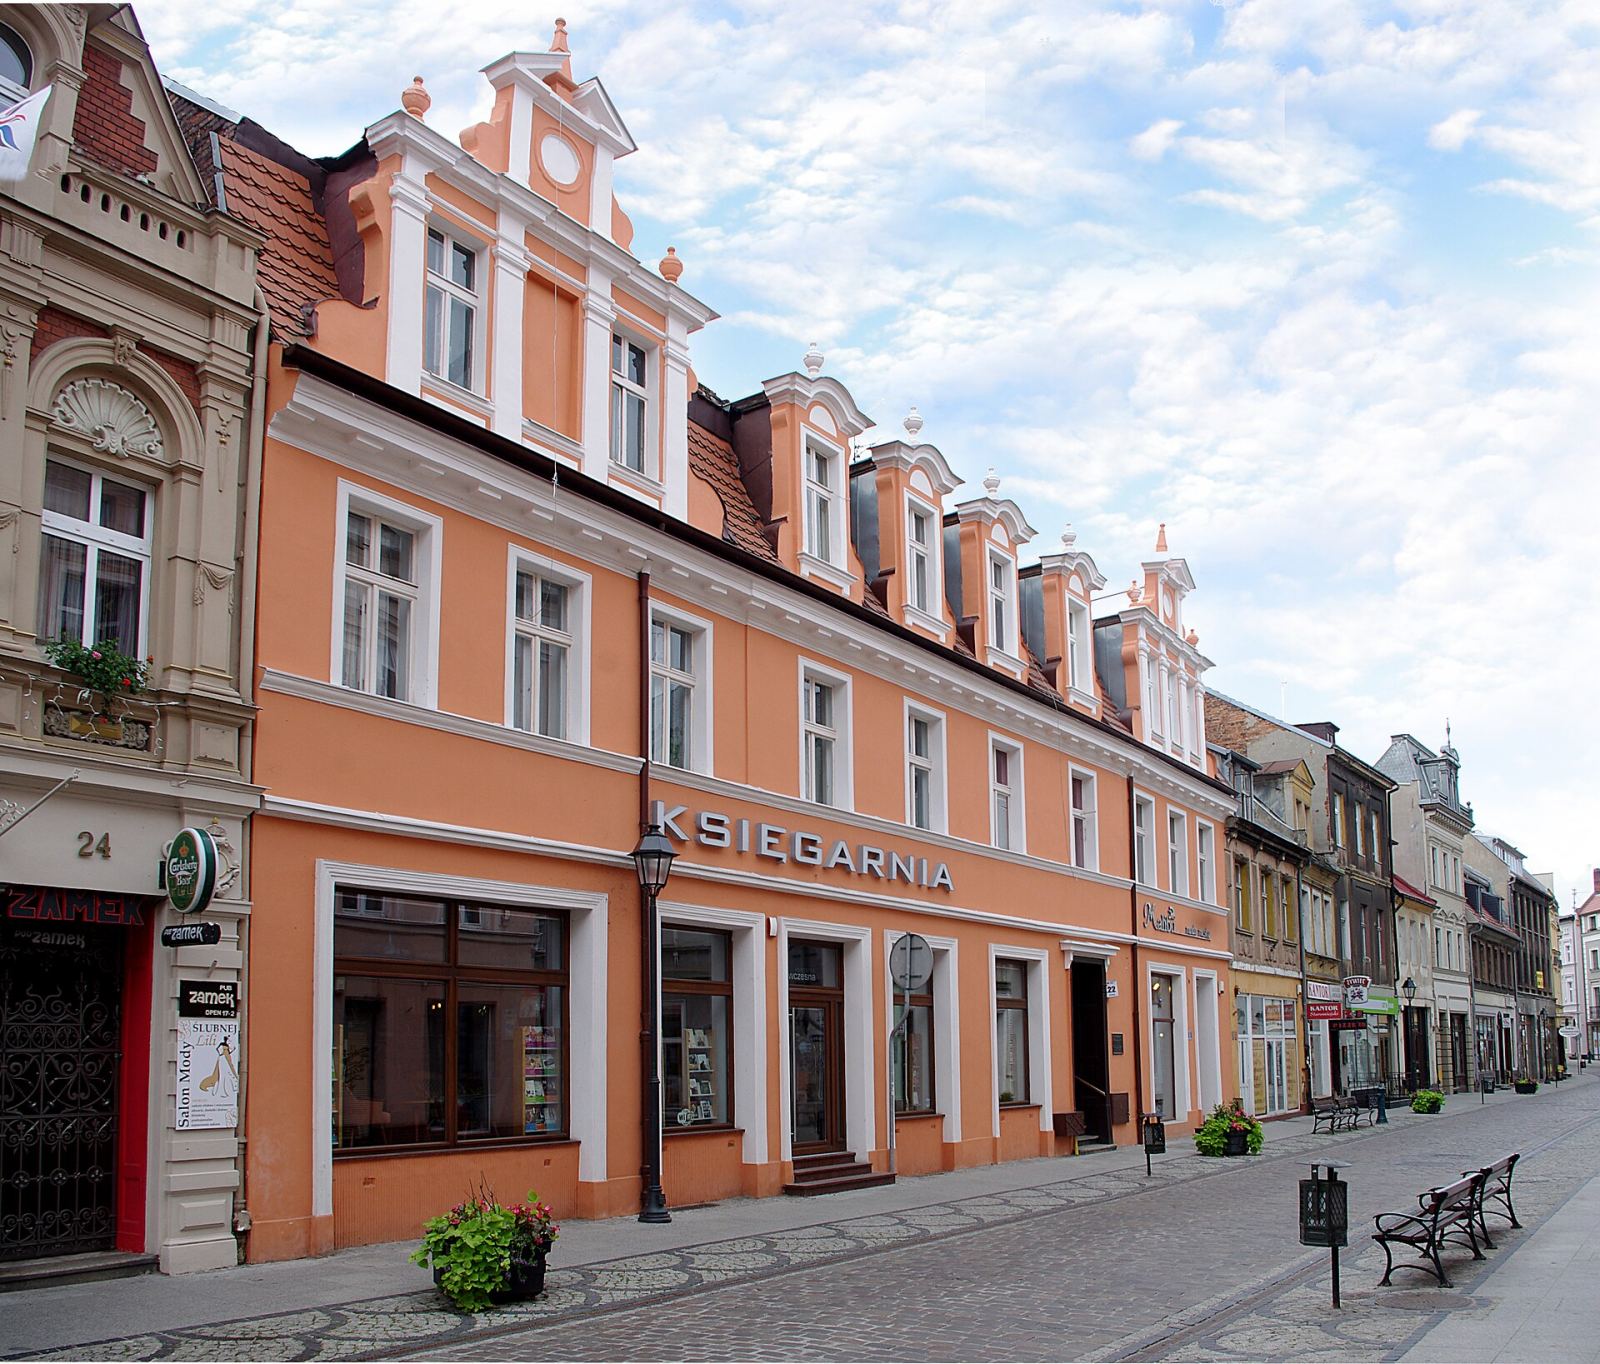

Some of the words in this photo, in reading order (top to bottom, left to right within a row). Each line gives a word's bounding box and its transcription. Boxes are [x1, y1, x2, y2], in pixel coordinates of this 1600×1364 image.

[78, 831, 112, 859] 24
[652, 800, 955, 892] KSIĘGARNIA
[169, 857, 198, 876] Carlsberg
[8, 888, 145, 926] ZAMEK
[32, 930, 87, 949] zamek
[171, 926, 204, 942] zamek
[1107, 985, 1117, 993] 22
[1308, 983, 1330, 998] KANTOR
[189, 991, 235, 1008] zamek
[179, 1041, 195, 1083] Mody
[178, 1088, 190, 1128] Salon
